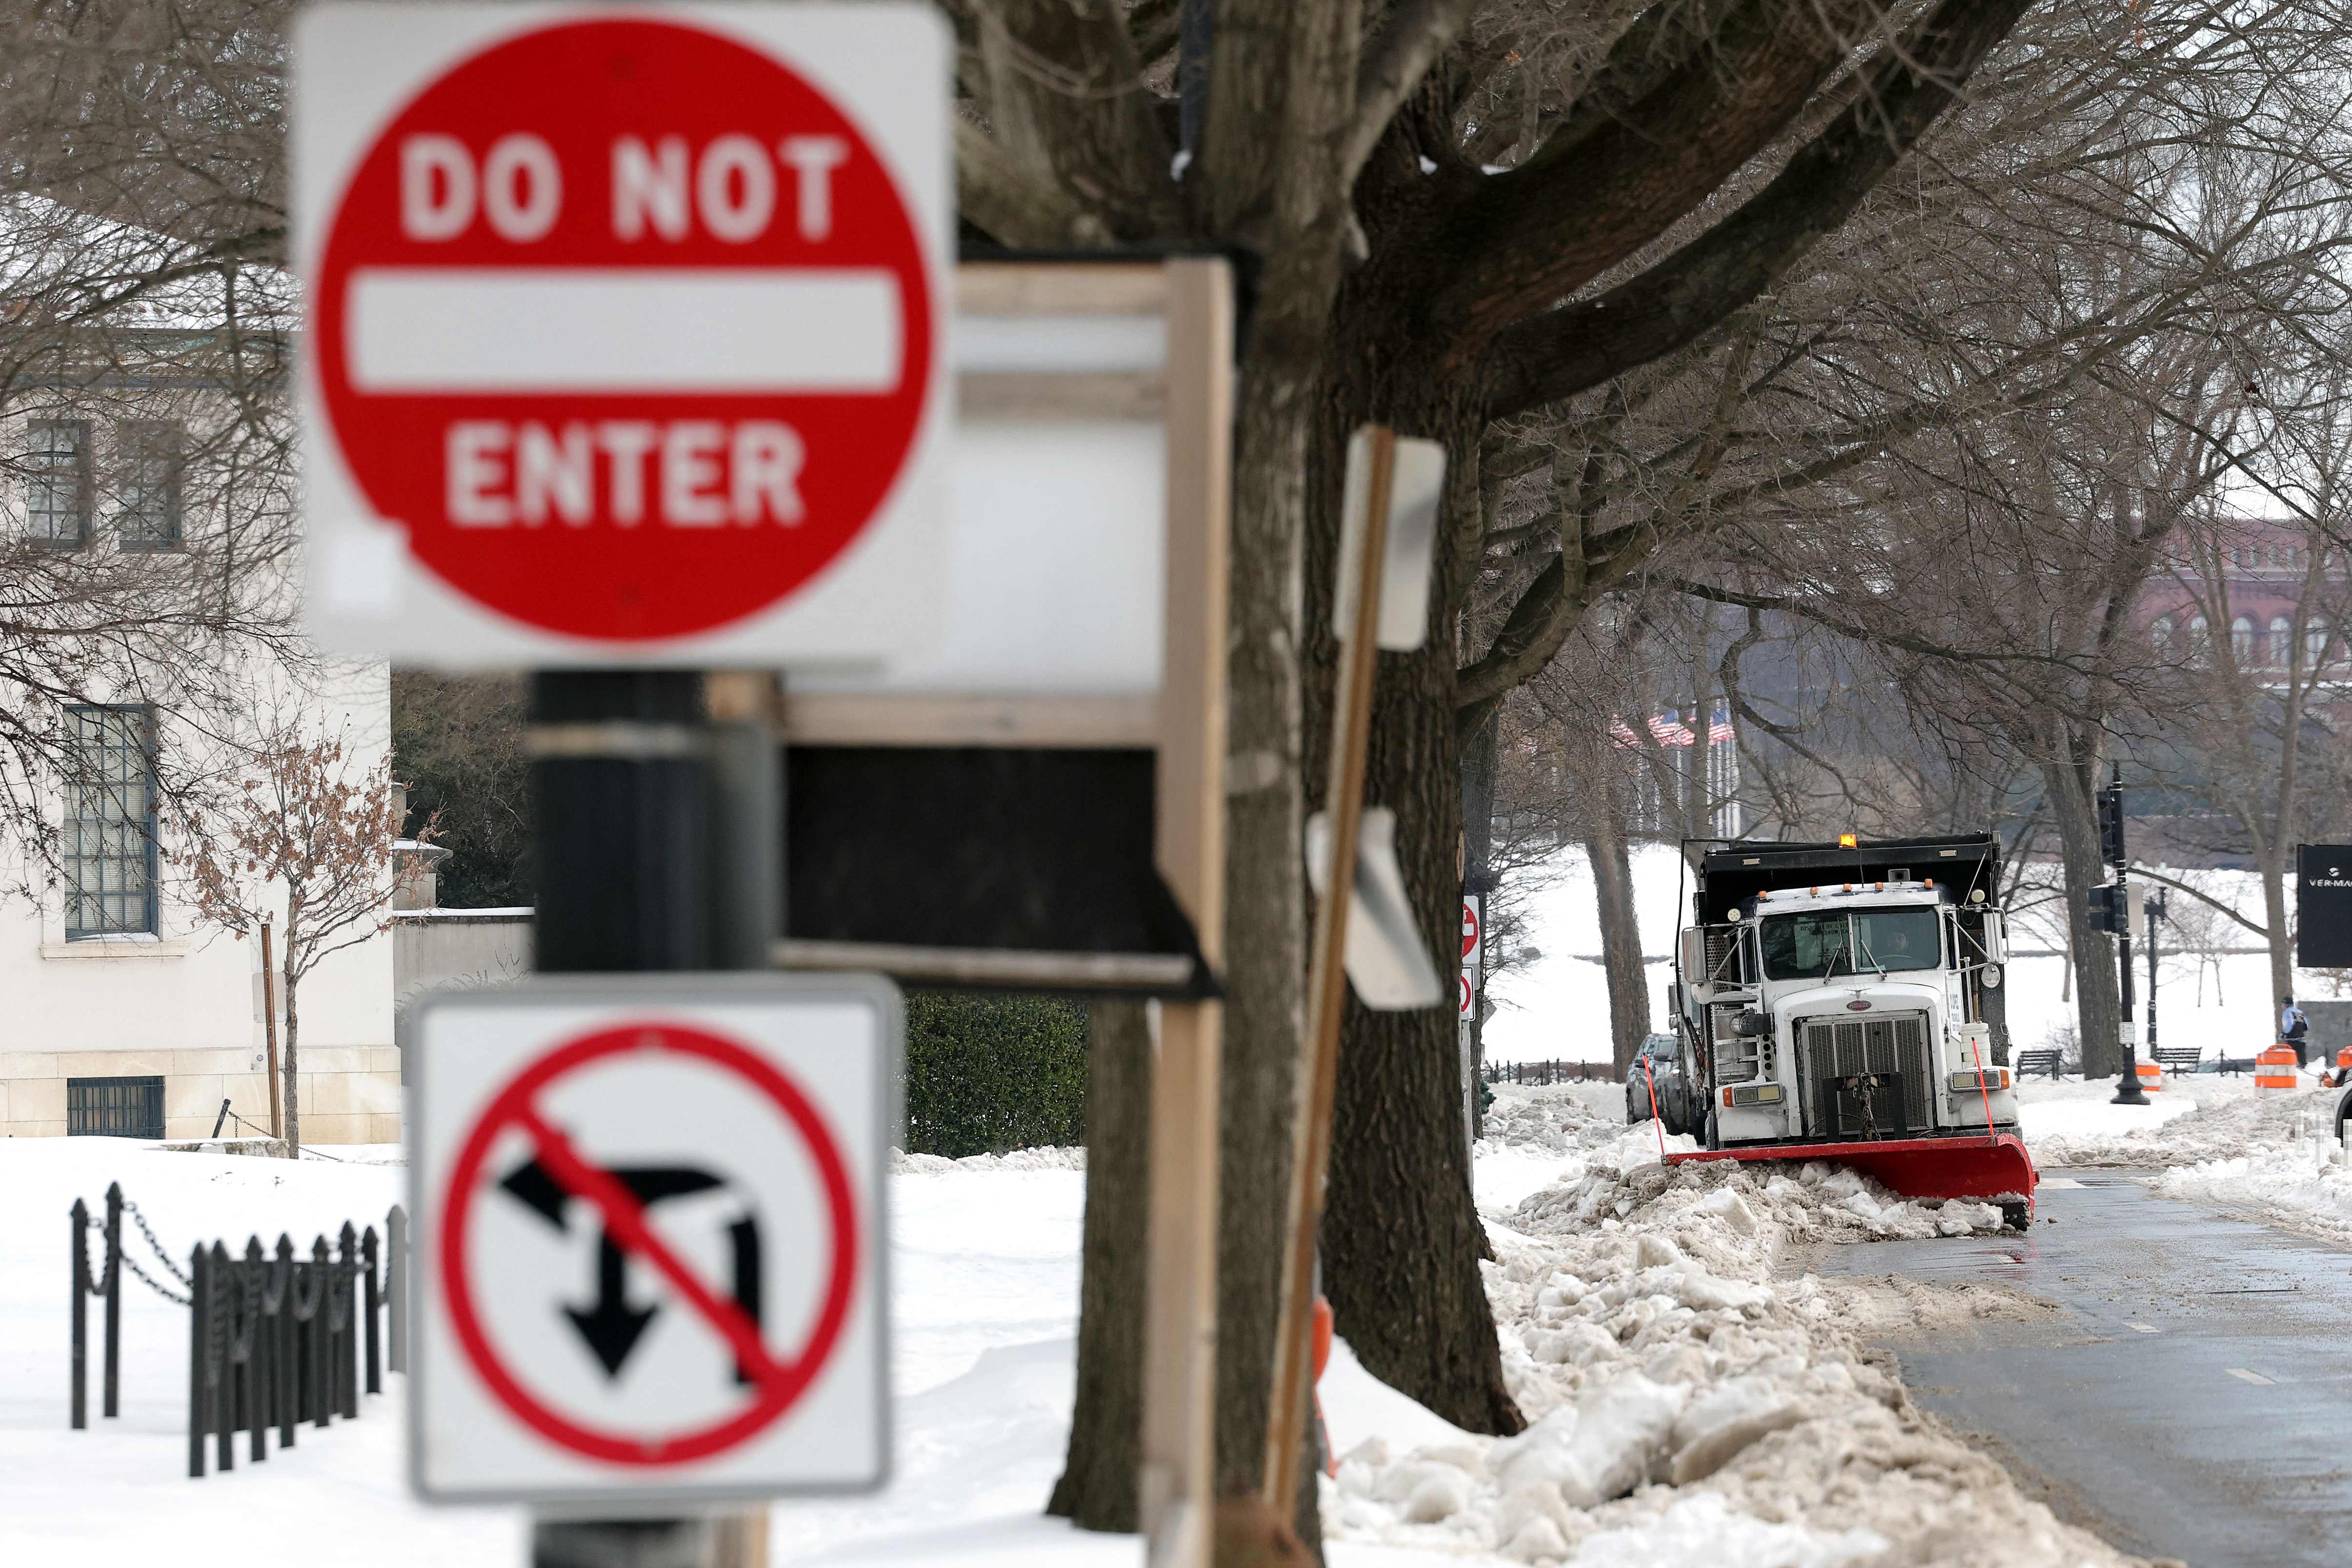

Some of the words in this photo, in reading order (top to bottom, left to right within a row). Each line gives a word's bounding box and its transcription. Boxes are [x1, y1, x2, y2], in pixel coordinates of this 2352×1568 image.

[400, 133, 562, 241] DO
[611, 133, 848, 242] NOT
[445, 420, 805, 527] ENTER
[2309, 879, 2352, 887] VER-MA
